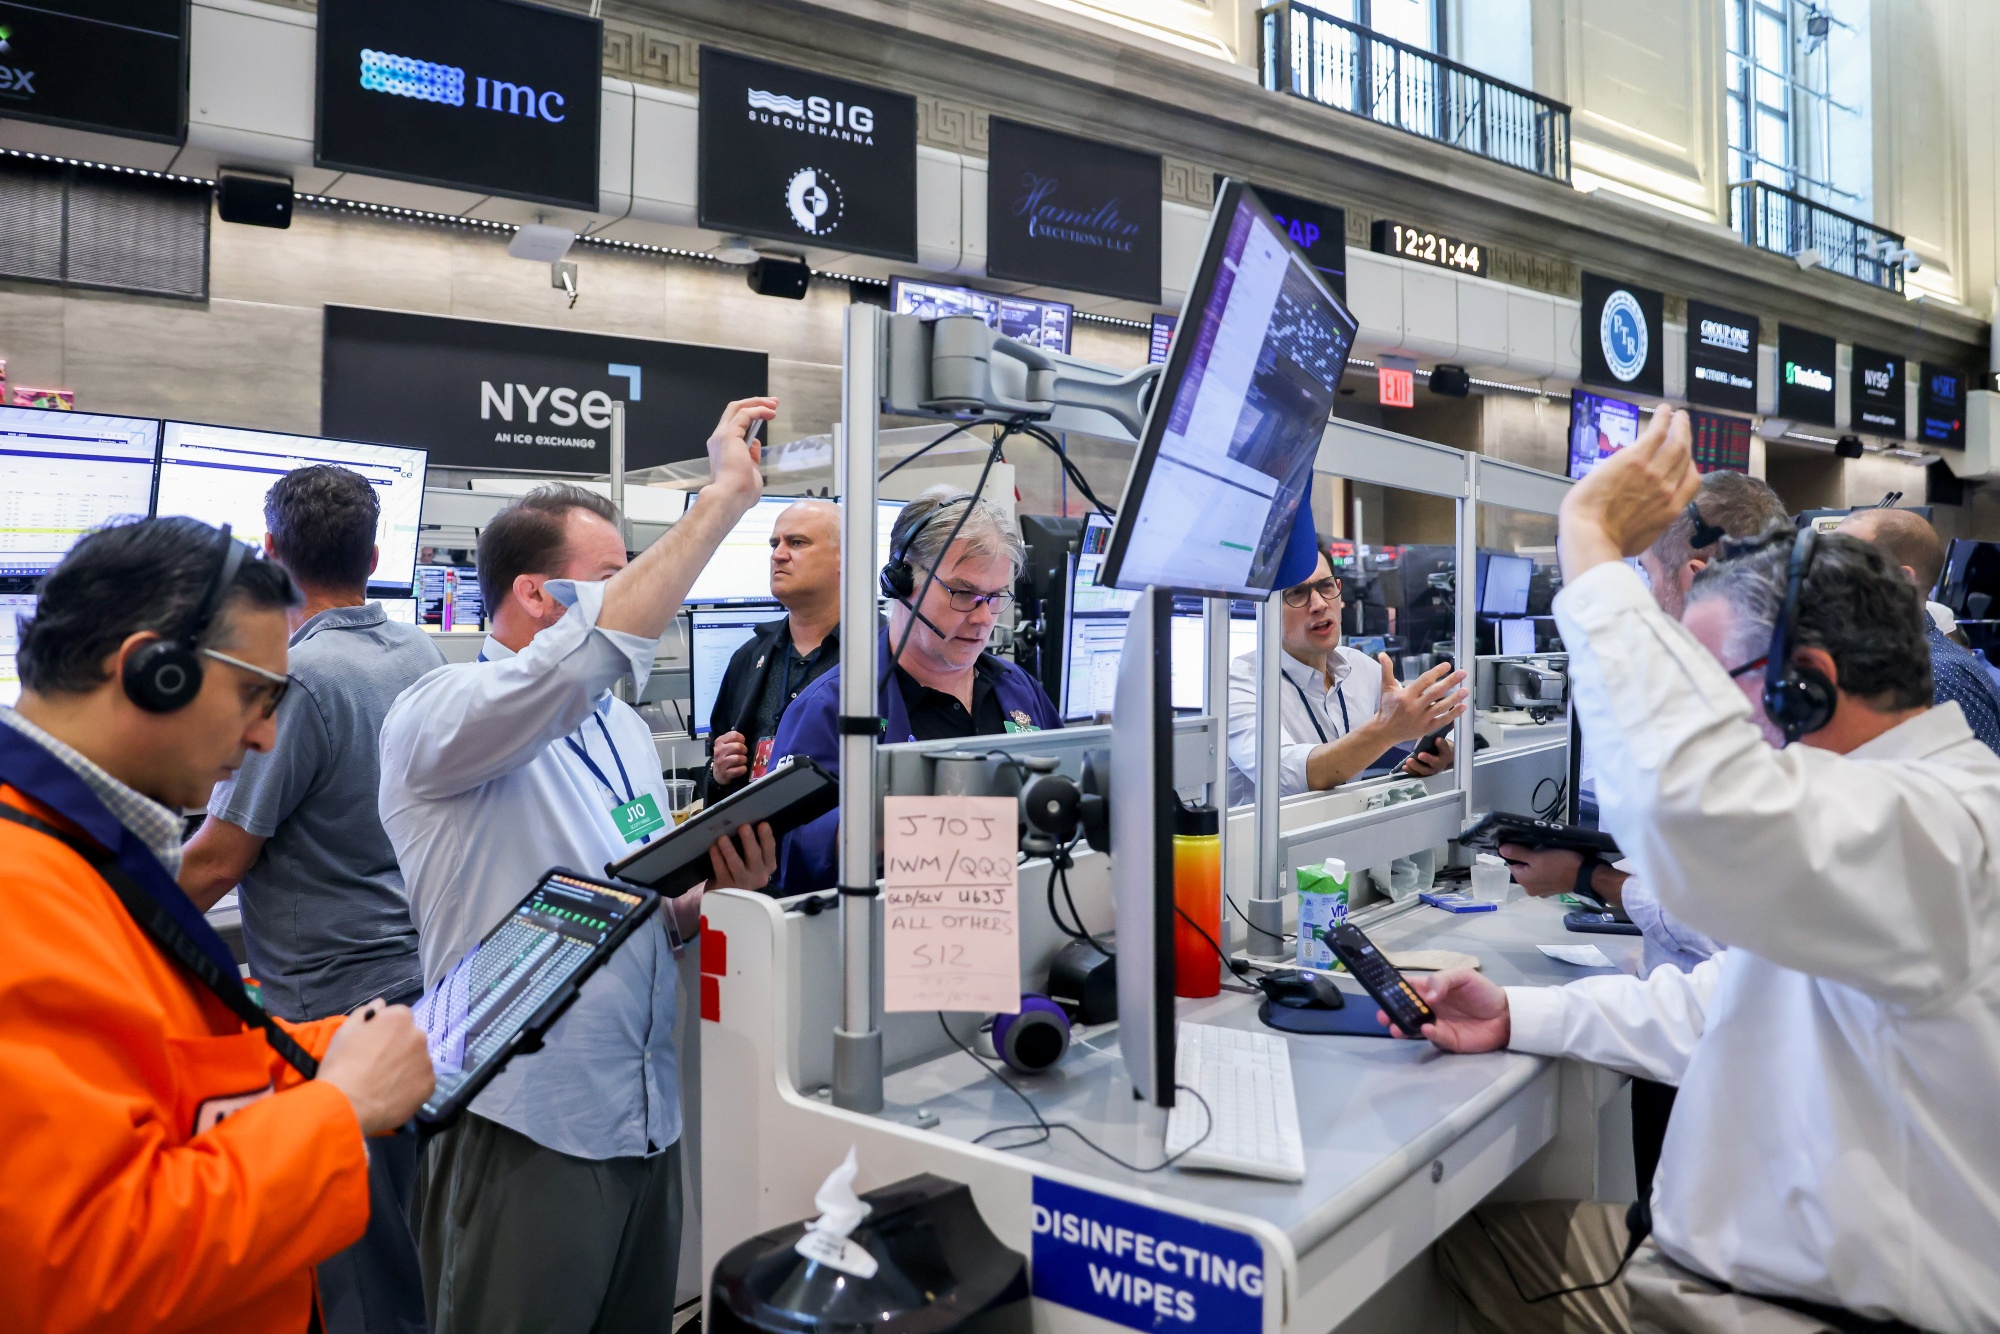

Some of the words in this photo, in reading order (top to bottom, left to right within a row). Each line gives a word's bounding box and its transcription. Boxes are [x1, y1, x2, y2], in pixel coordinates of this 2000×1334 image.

[748, 110, 874, 146] SUSQUEHANNA
[807, 95, 875, 133] SIG
[1012, 171, 1140, 236] Hamilton
[1393, 225, 1480, 273] 12:21:44
[1386, 374, 1410, 402] EXIT
[495, 433, 511, 442] AN
[627, 803, 646, 823] J10
[891, 915, 933, 931] ALL
[941, 914, 1014, 936] OTHERS
[1331, 904, 1348, 918] VITA
[1031, 1203, 1264, 1298] DISINFECTING
[1088, 1262, 1197, 1324] WIPES
